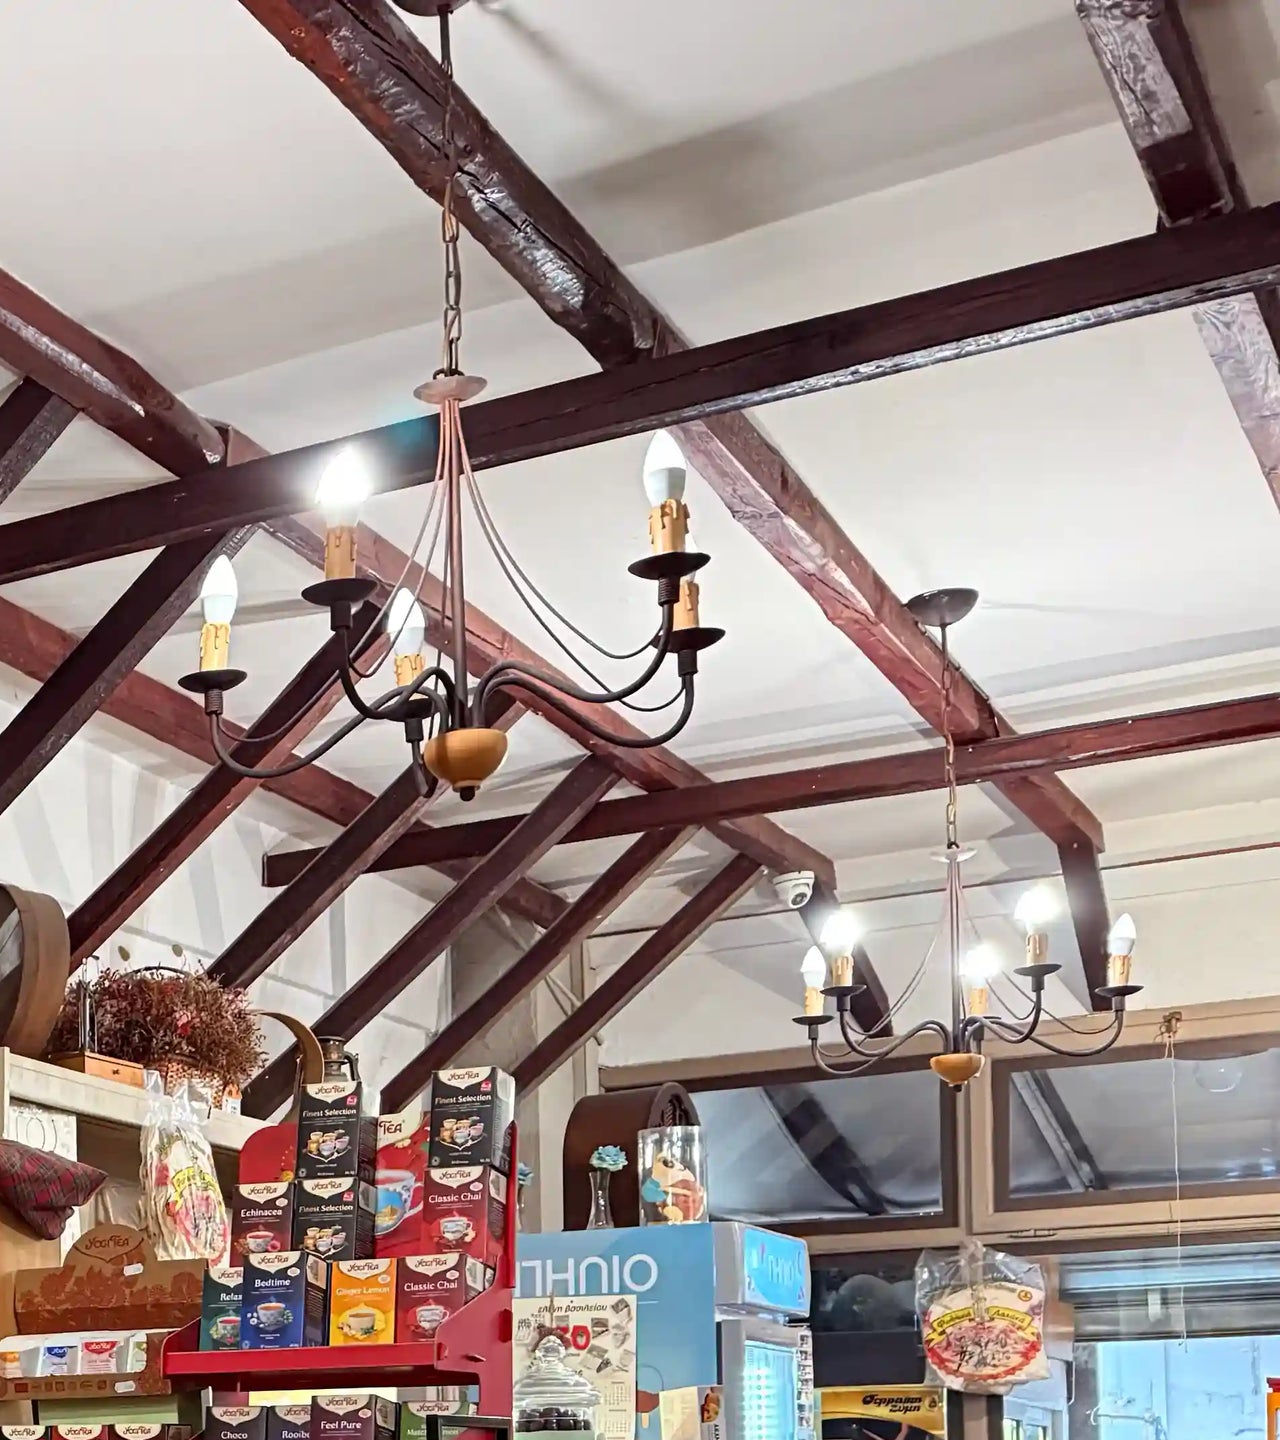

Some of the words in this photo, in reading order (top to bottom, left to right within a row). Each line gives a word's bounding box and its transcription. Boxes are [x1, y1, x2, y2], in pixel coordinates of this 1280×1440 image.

[458, 1093, 492, 1103] Selection
[303, 1109, 323, 1117] Finest
[324, 1108, 357, 1117] Selection
[428, 1193, 459, 1203] Classic
[461, 1191, 482, 1201] Chai
[240, 1207, 282, 1217] Echinacea
[320, 1202, 354, 1212] Selection
[254, 1277, 291, 1288] Bedtime
[404, 1282, 435, 1291] Classic
[437, 1279, 458, 1290] Chai
[363, 1286, 390, 1294] Lemon
[321, 1421, 339, 1429] Feel
[341, 1421, 362, 1429] Pure
[221, 1431, 248, 1439] Choco
